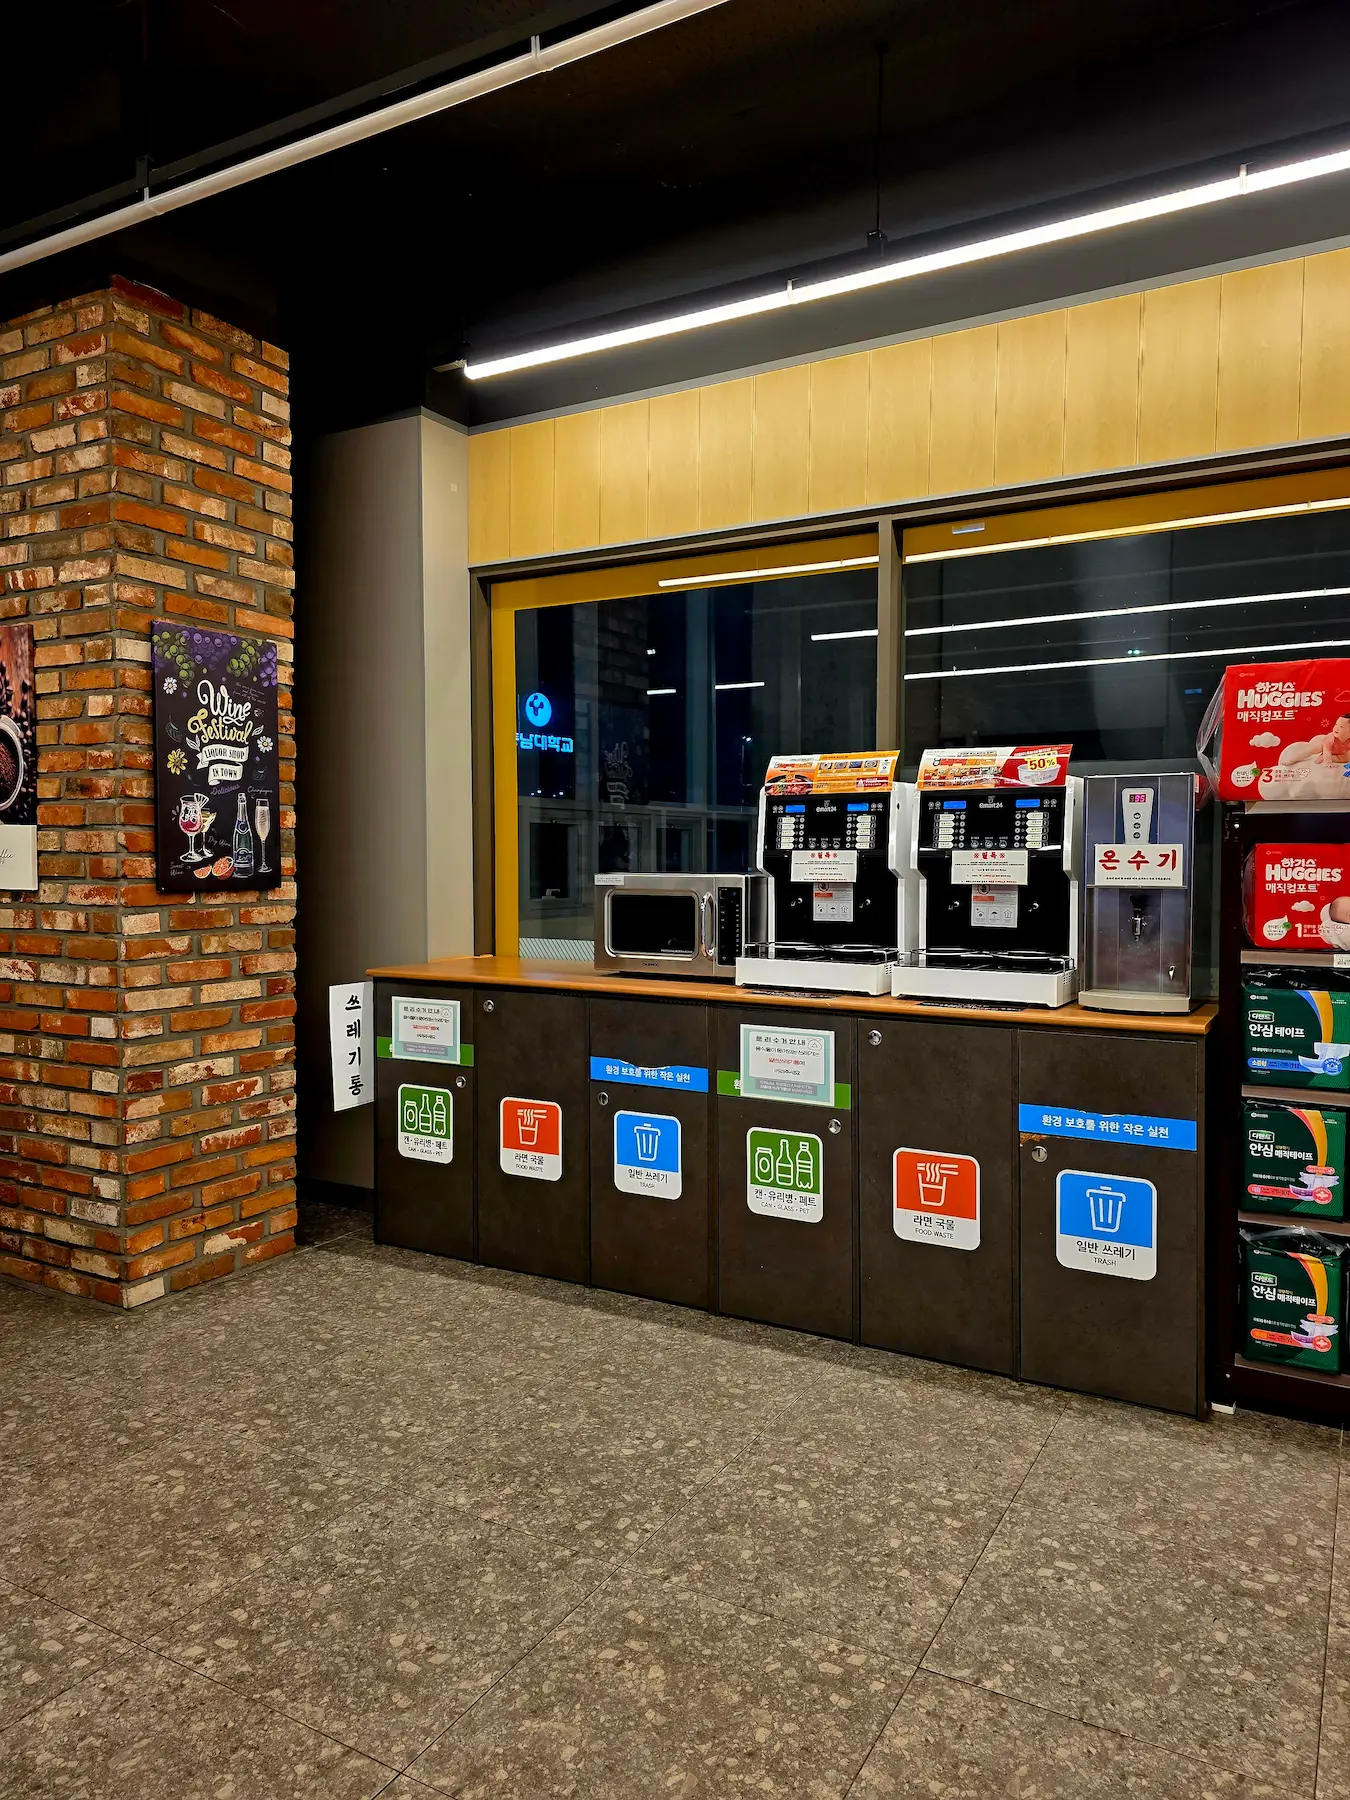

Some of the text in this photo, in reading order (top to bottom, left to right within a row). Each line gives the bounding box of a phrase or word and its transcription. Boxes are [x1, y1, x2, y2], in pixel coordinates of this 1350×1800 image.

[1255, 682, 1295, 693] 하기스
[197, 680, 251, 726] Wine
[1237, 689, 1323, 709] HUGGIES
[1237, 710, 1295, 723] 매직컴포트
[188, 708, 253, 745] Festival
[204, 748, 245, 760] LIQUOR SHOP
[1030, 758, 1056, 771] 50%
[213, 768, 238, 779] IN TOWN
[1262, 769, 1273, 783] 3
[210, 784, 240, 795] Delicious
[1099, 849, 1177, 872] 온수기
[1281, 858, 1317, 868] 하기스
[1266, 864, 1342, 883] HUGGIES
[1266, 883, 1318, 894] 매직컴포트
[1295, 923, 1302, 938] 1
[1249, 1024, 1305, 1038] 안심 테이프
[606, 1065, 691, 1083] 환경 보호를 위한 작은 실천
[1042, 1115, 1169, 1139] 환경 보호를 위한 작은 실천
[515, 1153, 544, 1165] 라면 국물
[1249, 1143, 1314, 1161] 안심 매직테이프
[628, 1169, 668, 1184] 일반 쓰레기
[914, 1215, 955, 1231] 라면 국물
[915, 1228, 954, 1239] FOOD WASTE
[1077, 1240, 1135, 1260] 일반 쓰레기
[1094, 1257, 1117, 1266] TRASH
[1252, 1285, 1317, 1307] 안심 매직테이프
